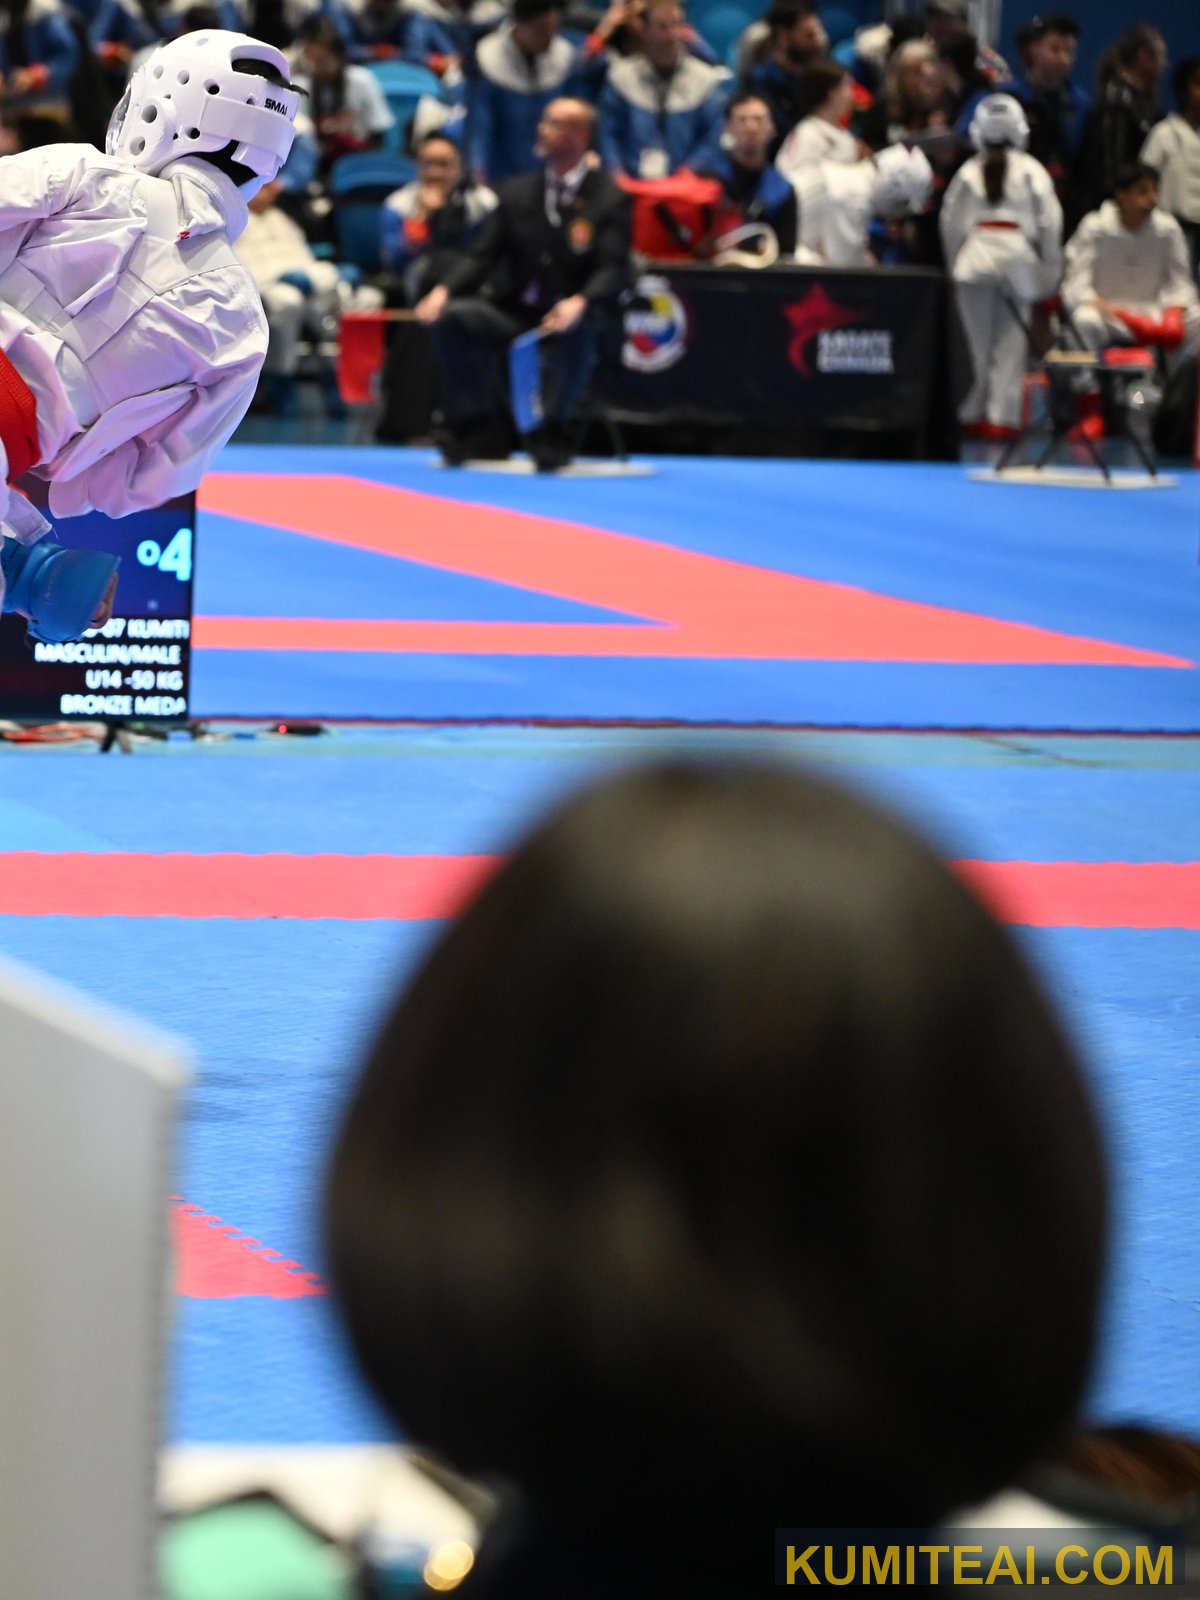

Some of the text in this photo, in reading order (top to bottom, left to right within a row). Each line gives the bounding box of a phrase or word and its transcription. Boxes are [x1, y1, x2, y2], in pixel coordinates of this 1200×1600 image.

[34, 642, 182, 666] MASCULIN/MALE
[85, 669, 123, 690] U14
[156, 670, 184, 691] KG
[60, 693, 133, 716] BRONZE
